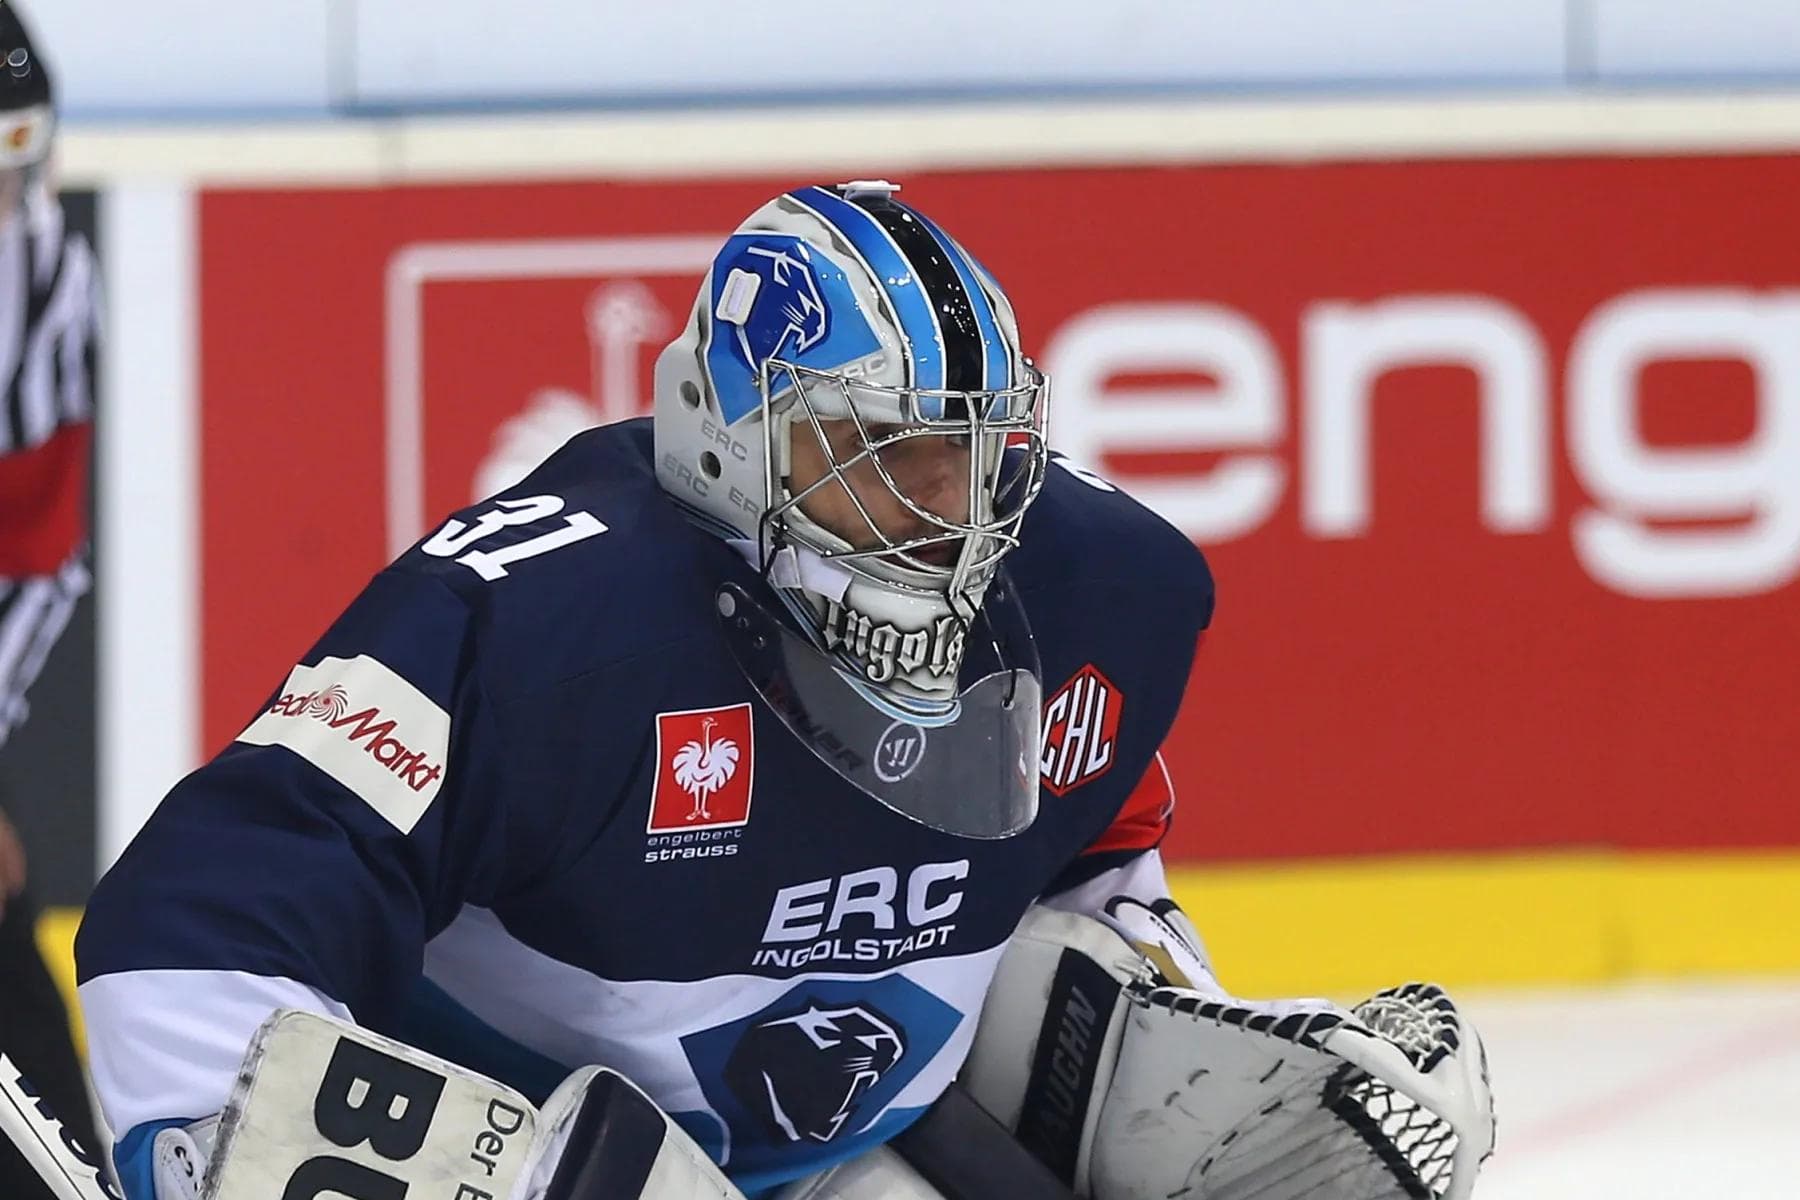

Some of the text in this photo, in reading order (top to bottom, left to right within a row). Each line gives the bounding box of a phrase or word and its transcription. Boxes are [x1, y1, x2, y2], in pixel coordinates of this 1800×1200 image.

[701, 418, 748, 462] ERC
[663, 453, 710, 498] ERC
[728, 484, 763, 519] ER
[420, 494, 610, 582] 31
[328, 707, 441, 792] Markt
[1040, 675, 1111, 787] CHL
[645, 844, 738, 863] strauss
[647, 828, 742, 847] engelbert
[761, 859, 970, 943] ERC
[751, 924, 956, 968] INGOLSTADT
[470, 1097, 525, 1177] Der
